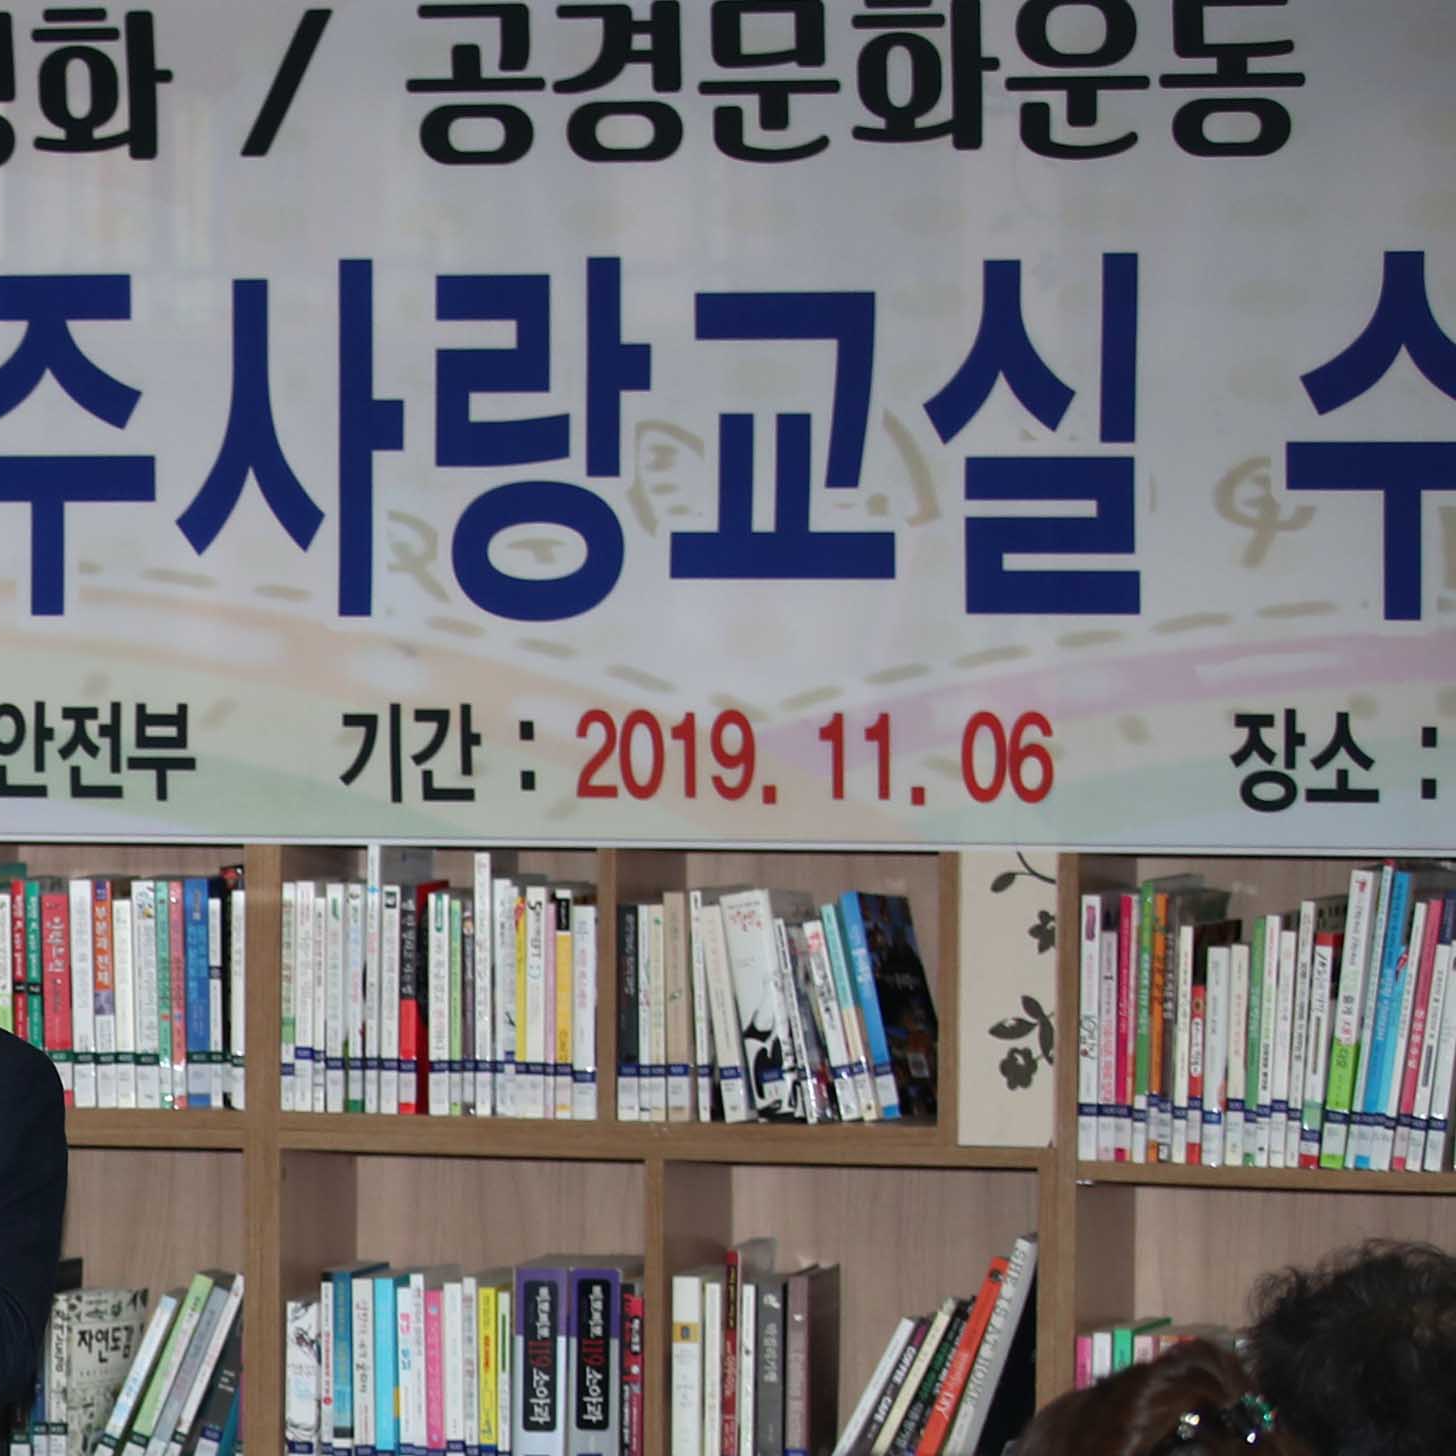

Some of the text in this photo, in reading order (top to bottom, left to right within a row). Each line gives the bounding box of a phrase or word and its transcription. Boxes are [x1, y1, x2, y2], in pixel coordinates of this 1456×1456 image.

[404, 0, 1308, 167] 공경문화운동
[338, 702, 483, 805] 기간
[961, 710, 1054, 804] 06
[1228, 707, 1381, 814] 장소
[76, 1325, 136, 1365] 자연도감
[891, 1345, 918, 1385] COFFEE
[528, 1367, 551, 1425] 소아과
[582, 1366, 604, 1423] 소아과
